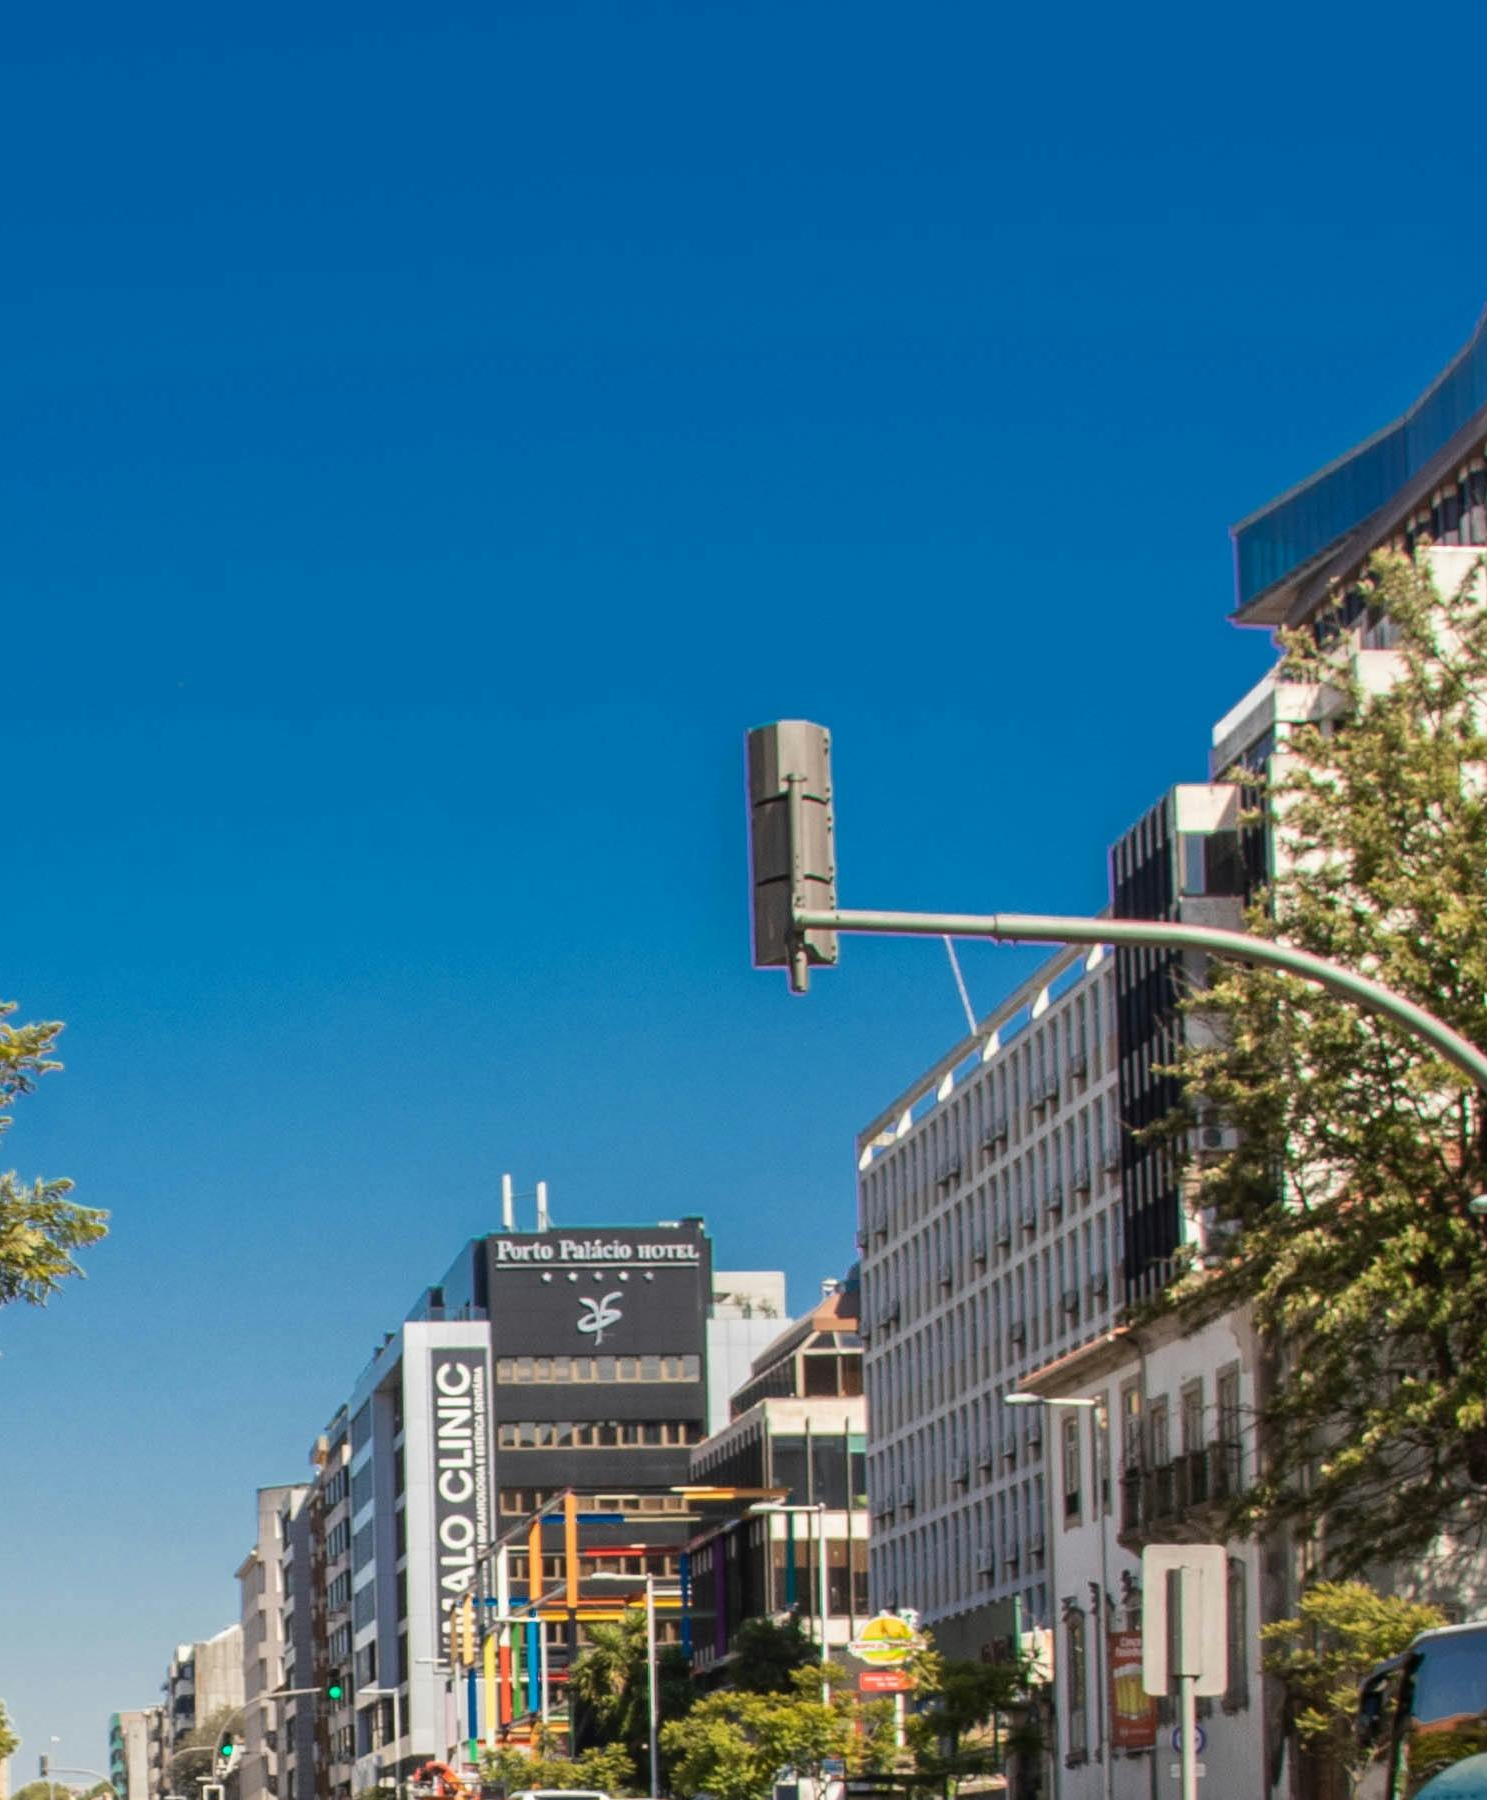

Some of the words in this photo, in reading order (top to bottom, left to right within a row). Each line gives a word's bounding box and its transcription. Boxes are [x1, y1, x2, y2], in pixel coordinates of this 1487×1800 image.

[496, 1240, 554, 1261] Porto
[559, 1237, 632, 1261] Palácio
[637, 1243, 700, 1260] HOTEL
[435, 1362, 474, 1504] CLINIC
